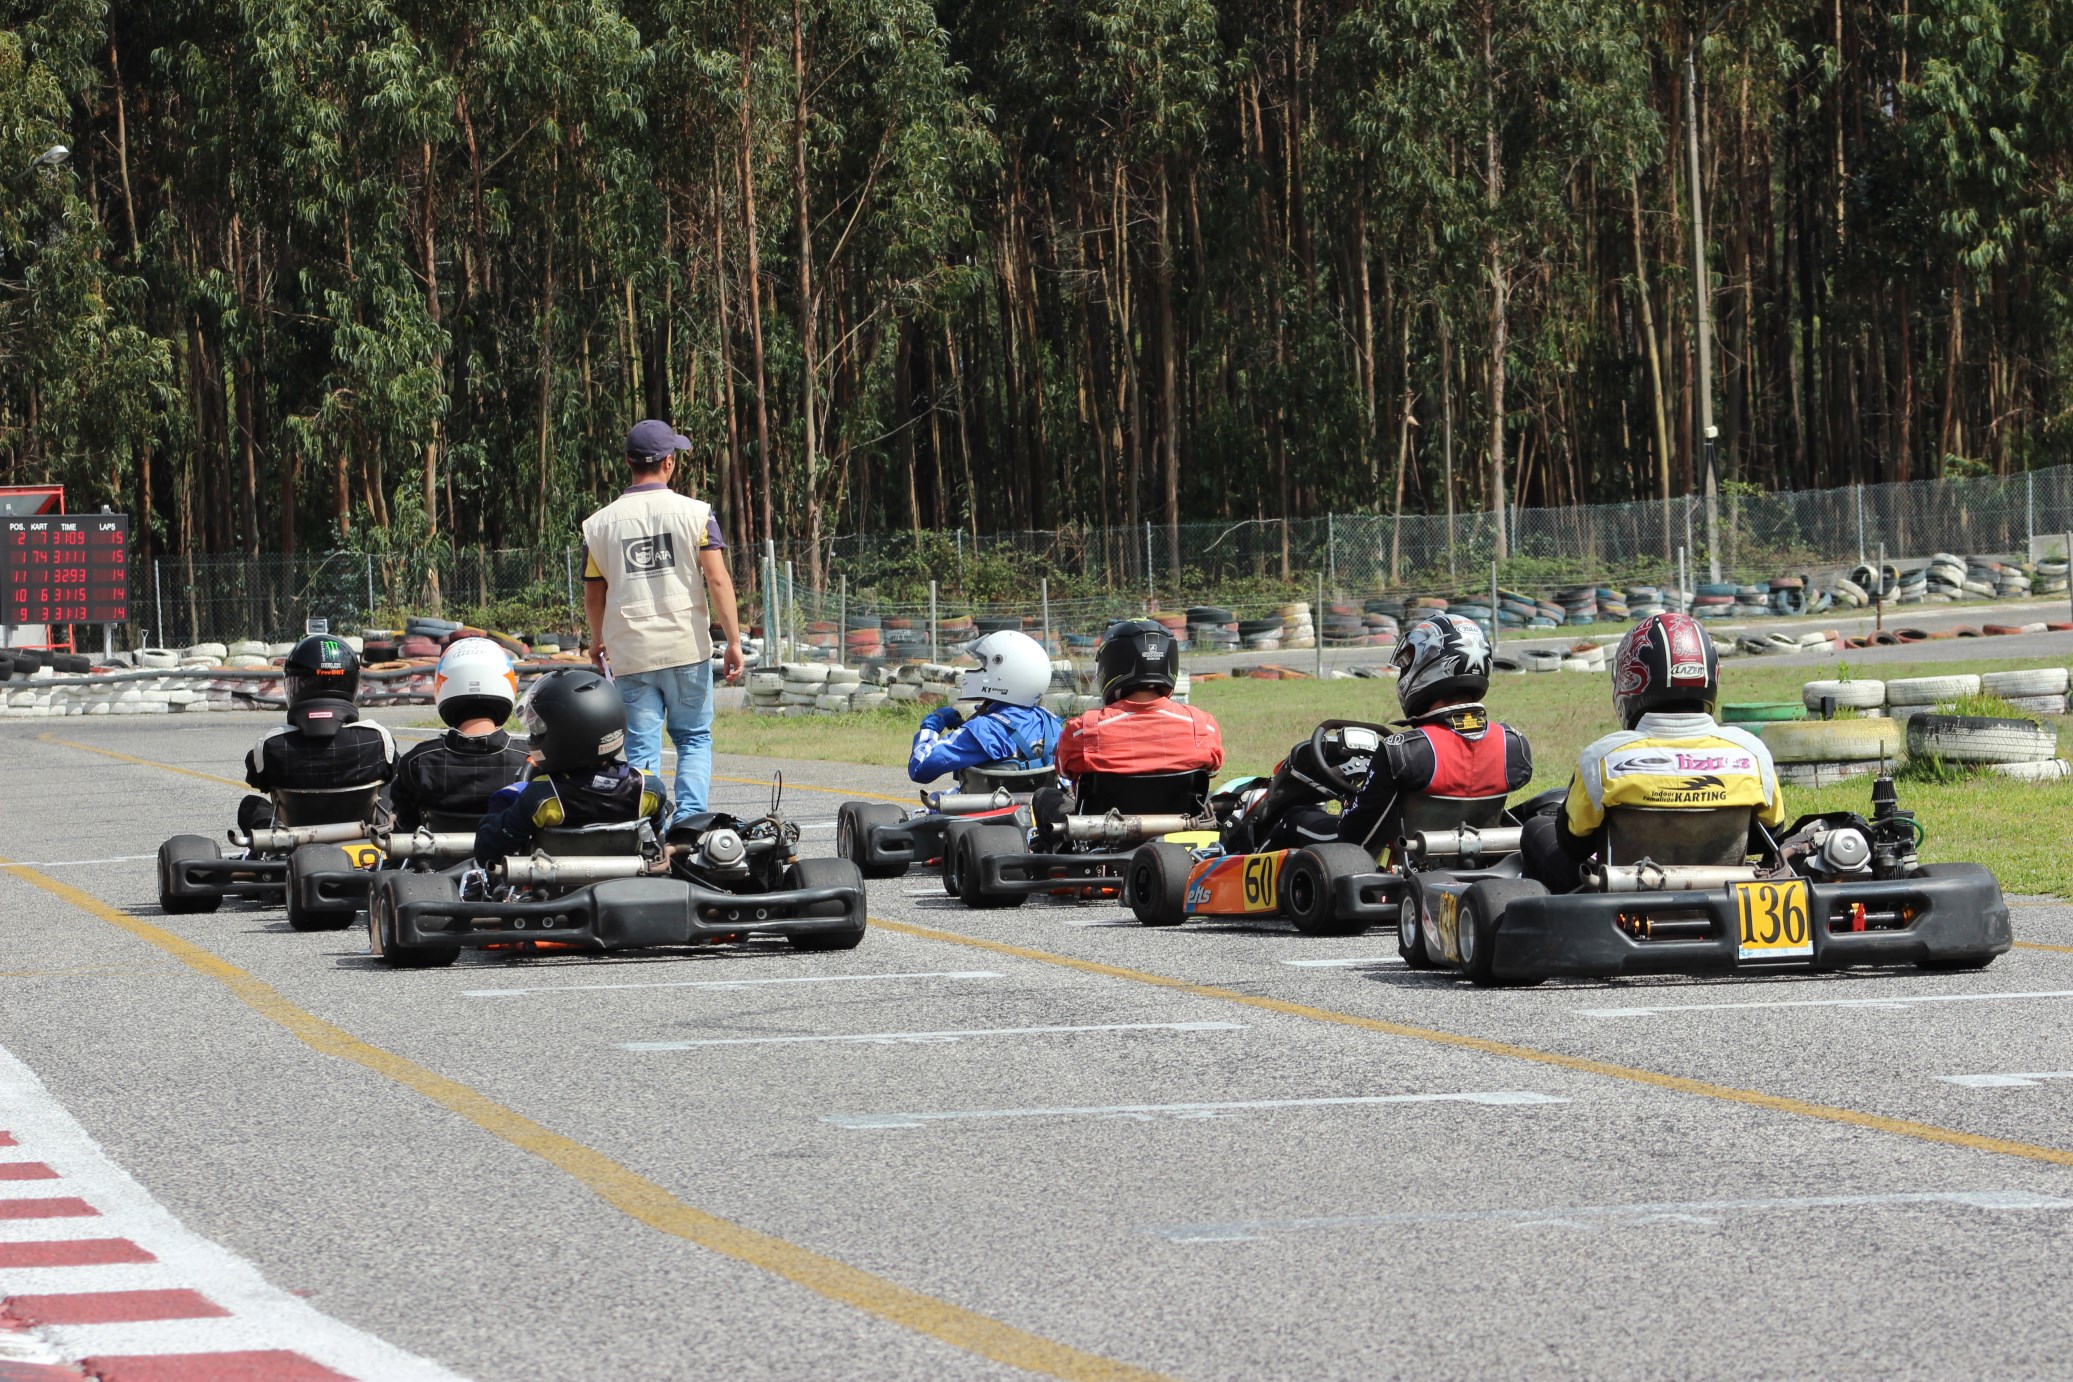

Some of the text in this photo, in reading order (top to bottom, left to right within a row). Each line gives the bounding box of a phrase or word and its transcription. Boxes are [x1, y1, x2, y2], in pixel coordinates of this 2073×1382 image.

[9, 523, 116, 531] POS. KART TIME LAPS
[17, 531, 26, 545] 2
[40, 531, 48, 545] 7
[111, 531, 124, 545] 15
[33, 550, 48, 564] 74
[111, 550, 124, 563] 15
[14, 570, 27, 583] 11
[112, 570, 125, 582] 14
[15, 588, 27, 603] 10
[40, 588, 49, 603] 6
[113, 588, 125, 600] 14
[20, 607, 28, 622] 9
[42, 607, 49, 621] 3
[113, 608, 125, 620] 14
[1675, 791, 1726, 803] KARTING
[1245, 856, 1273, 906] 60
[1738, 884, 1805, 944] 136
